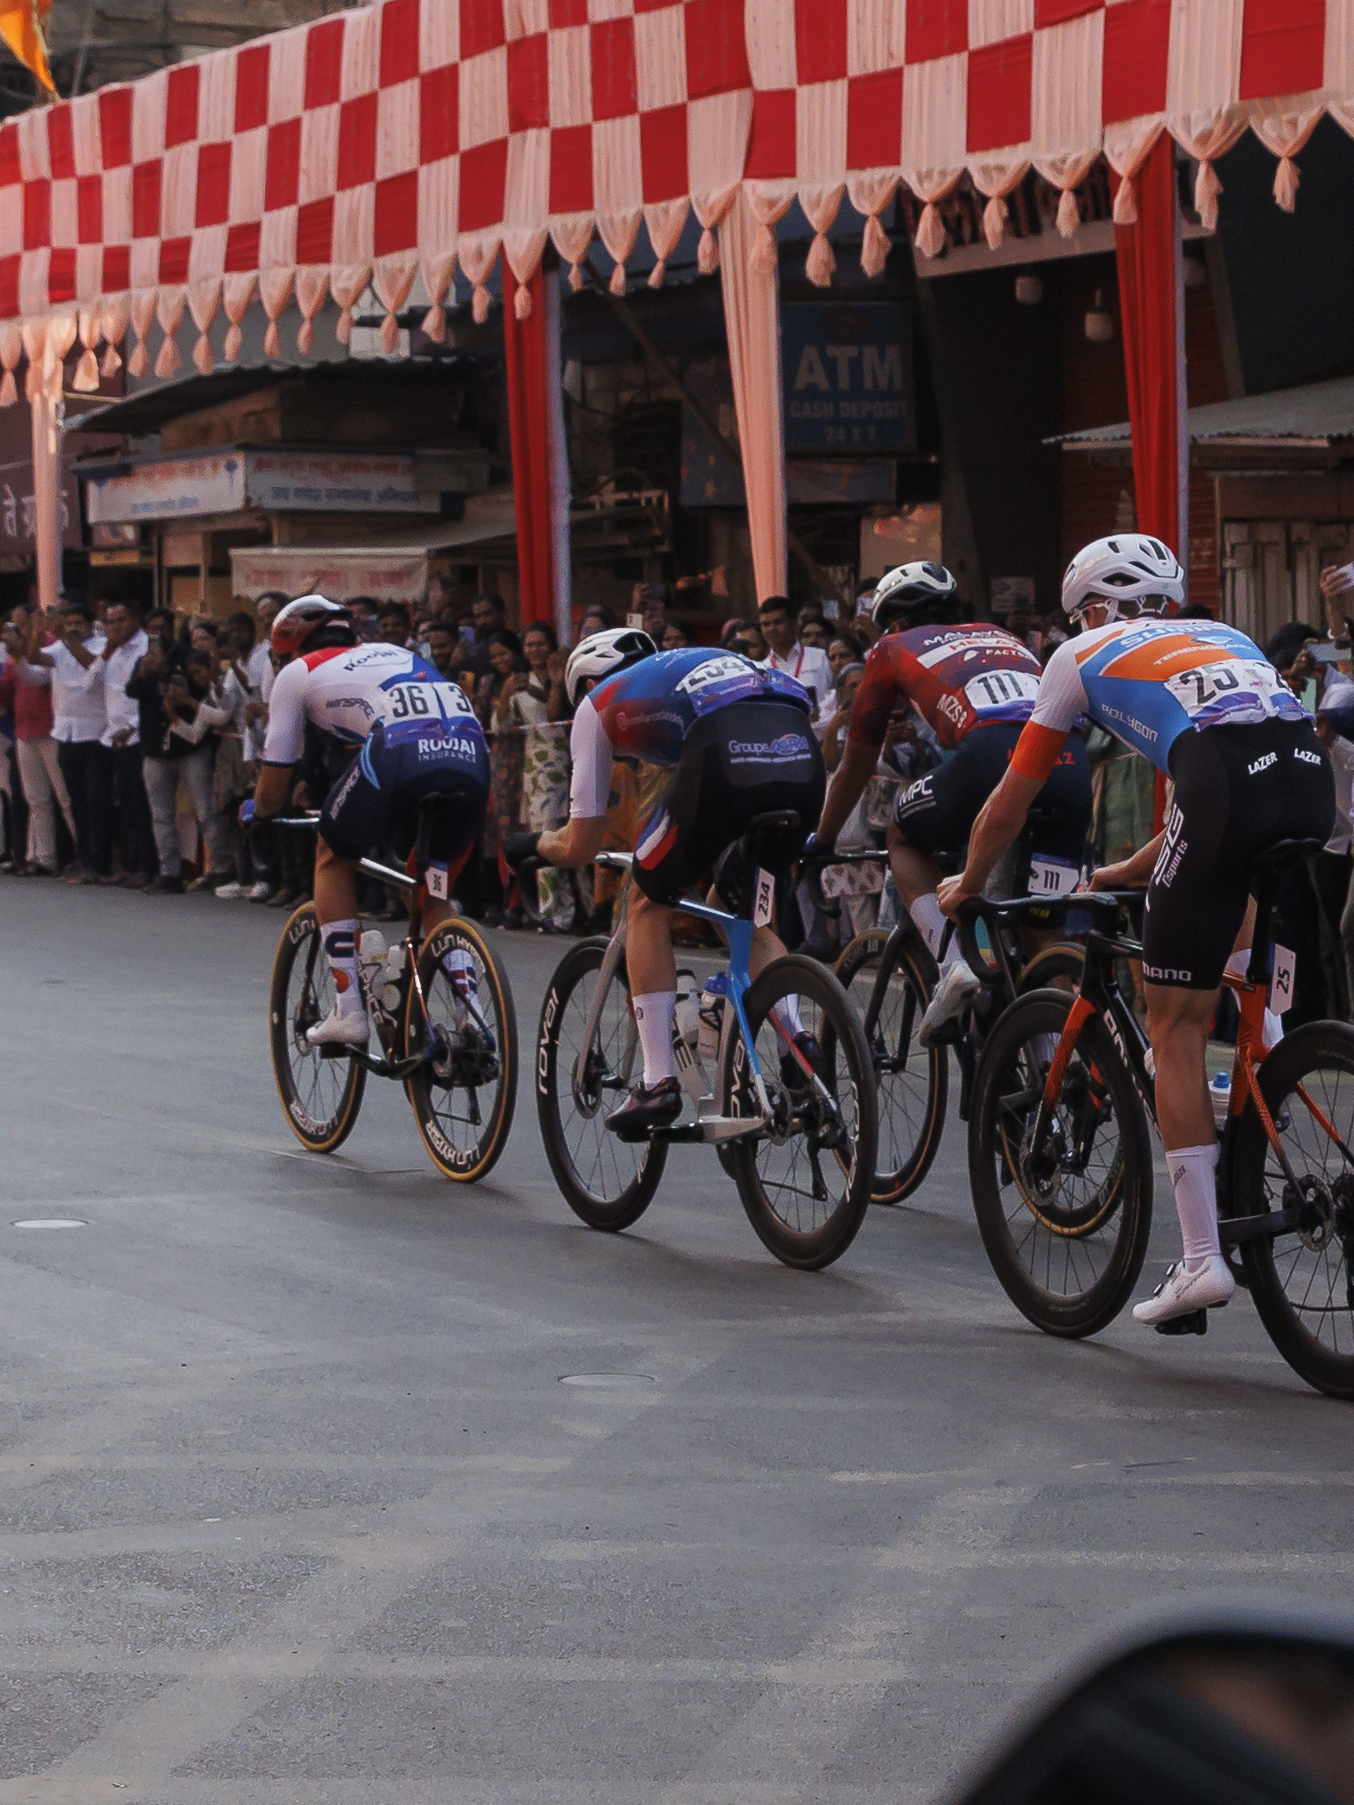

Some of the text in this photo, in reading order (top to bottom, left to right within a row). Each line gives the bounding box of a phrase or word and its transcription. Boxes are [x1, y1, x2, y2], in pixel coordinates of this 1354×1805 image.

[793, 344, 903, 392] ATM
[790, 400, 908, 419] CASH DEPOSIT
[825, 425, 846, 443] 24
[867, 425, 878, 443] 7
[977, 671, 1025, 706] 111
[1179, 662, 1240, 706] 25
[389, 685, 472, 718] 36 3
[418, 752, 478, 764] INSURANCE
[728, 741, 770, 755] Groupe
[1247, 747, 1322, 776] LAZER LAZER
[758, 875, 770, 916] 234
[1043, 869, 1061, 891] 111
[1275, 964, 1291, 995] 25
[539, 987, 559, 1096] roval
